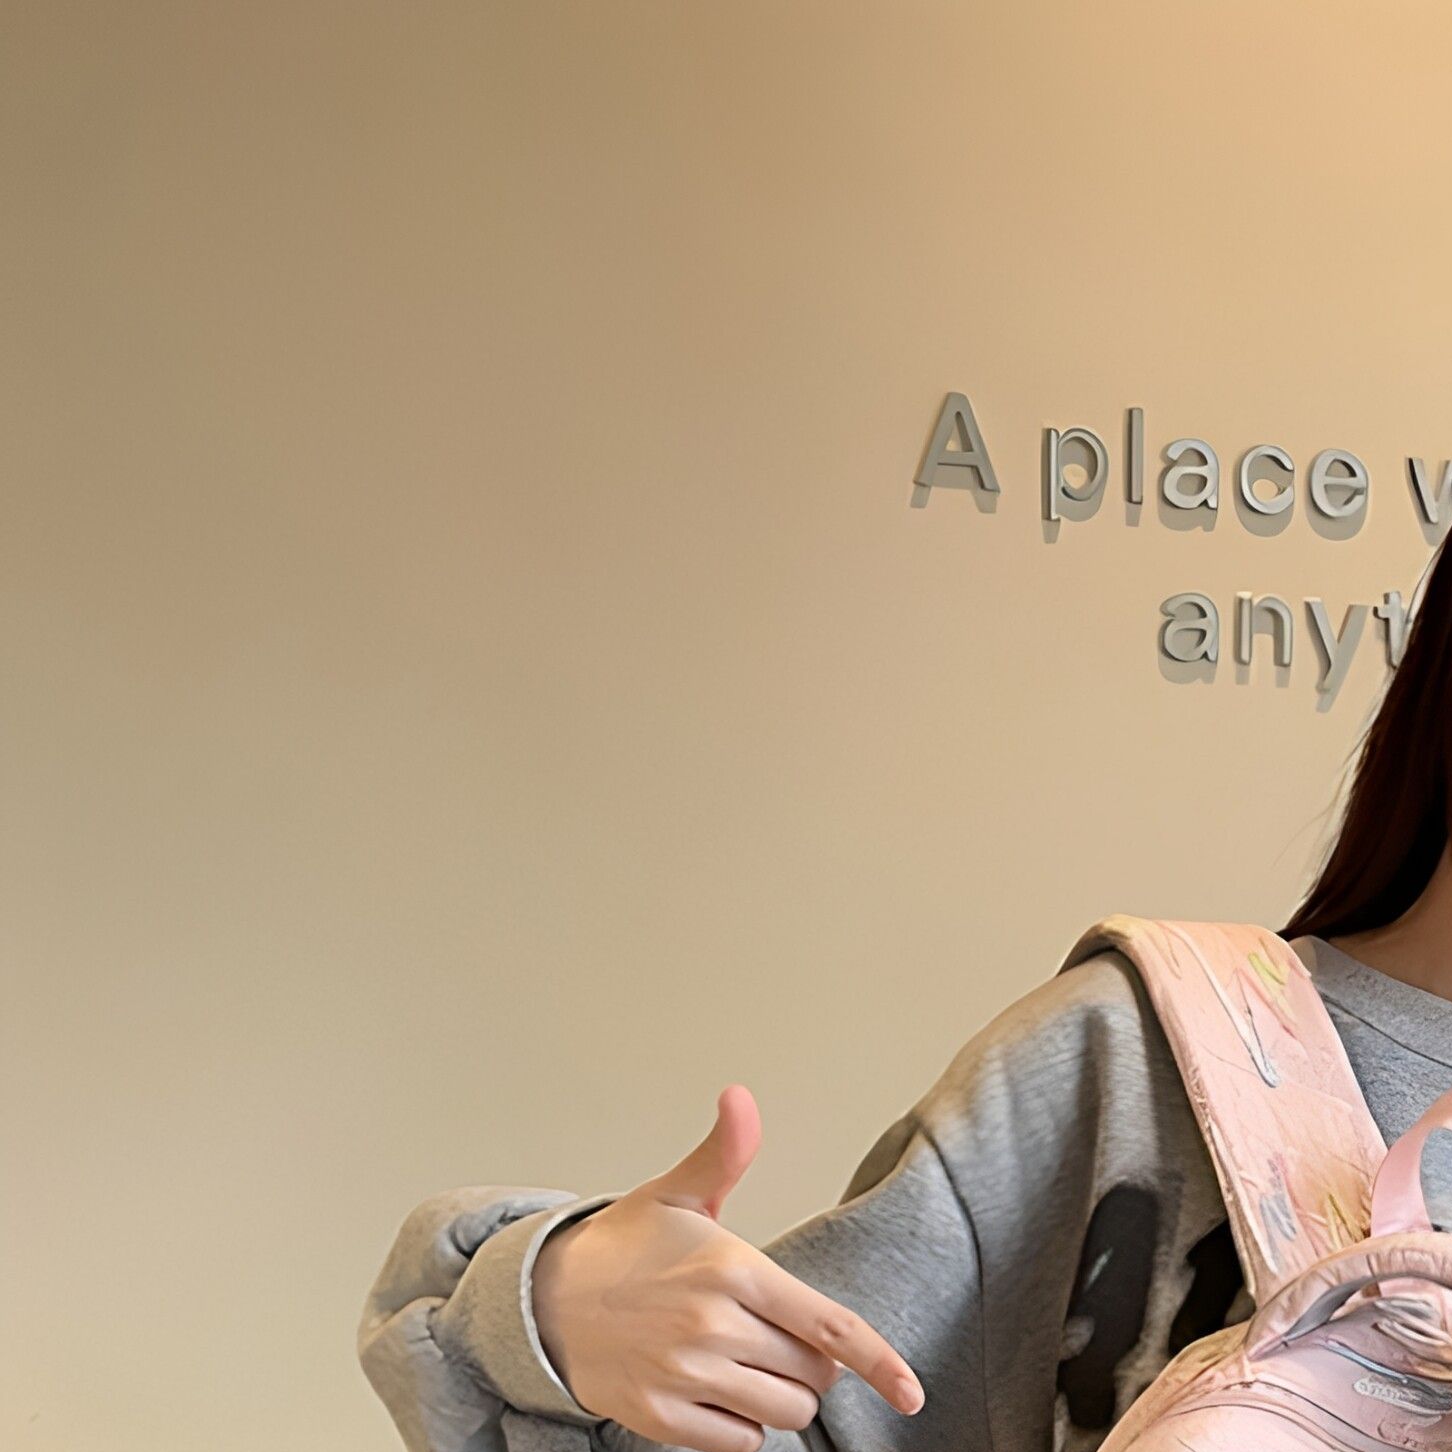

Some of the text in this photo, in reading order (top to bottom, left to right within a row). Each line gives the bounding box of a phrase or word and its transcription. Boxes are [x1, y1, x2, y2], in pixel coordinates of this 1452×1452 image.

[914, 391, 1000, 493] A
[1044, 407, 1368, 521] place
[1158, 591, 1408, 692] anyt
